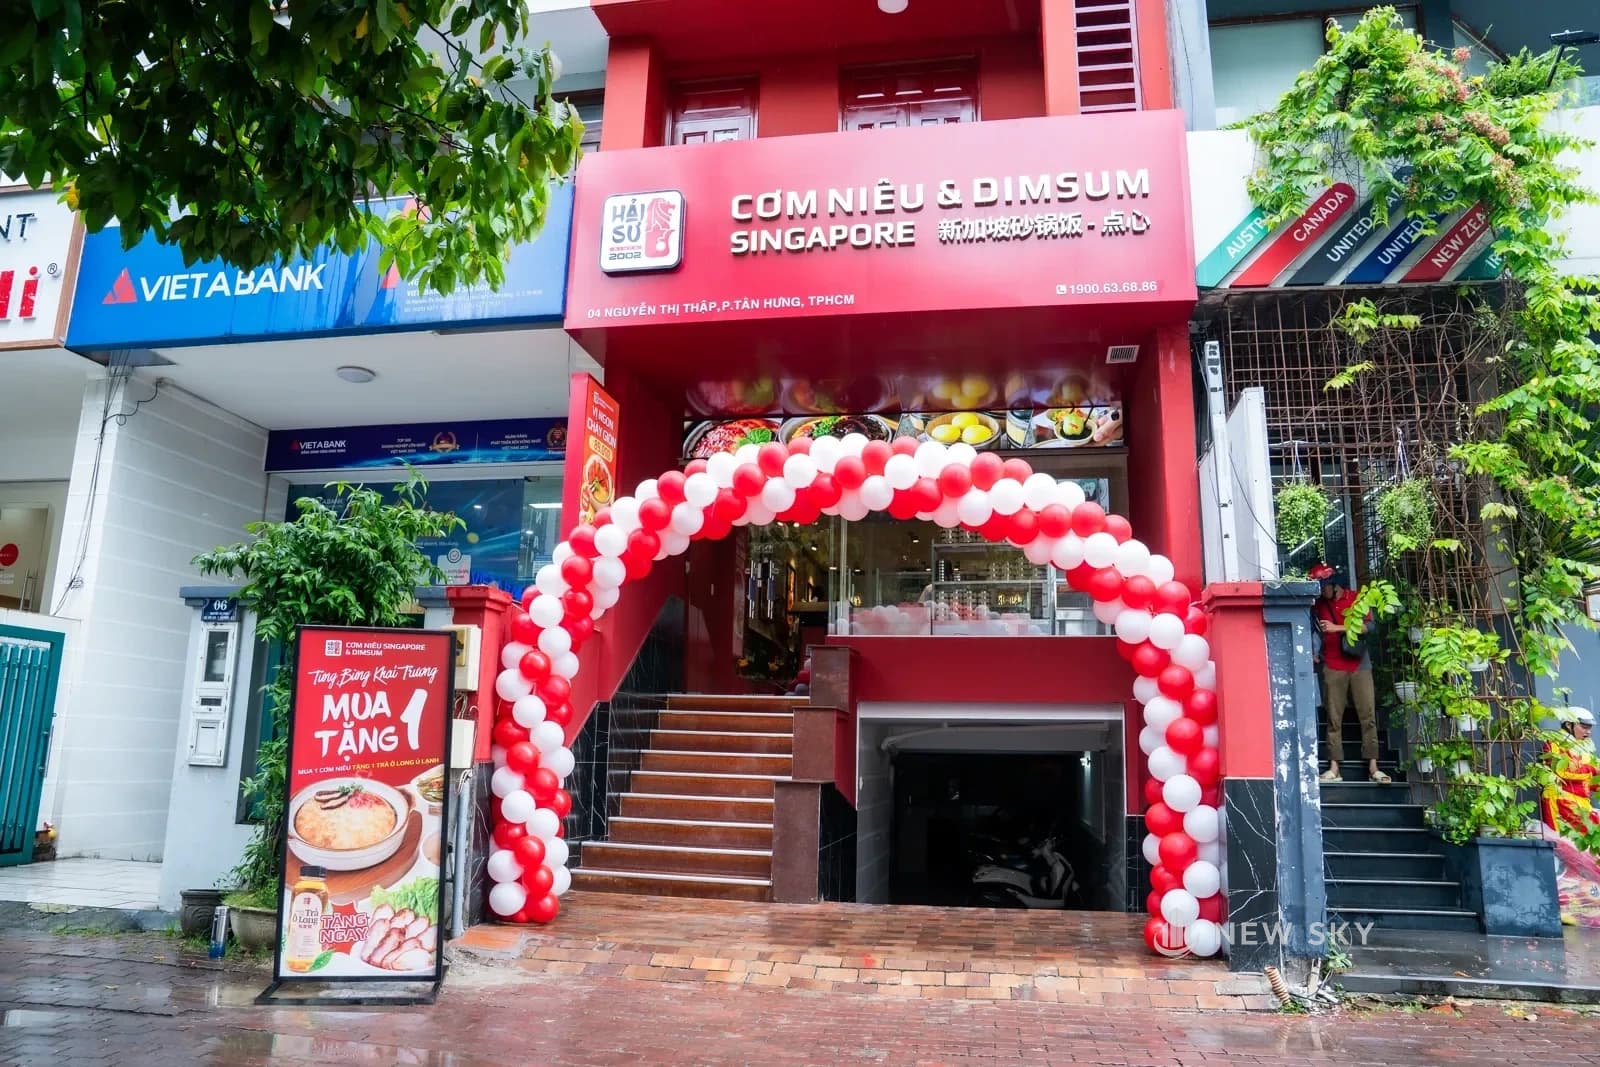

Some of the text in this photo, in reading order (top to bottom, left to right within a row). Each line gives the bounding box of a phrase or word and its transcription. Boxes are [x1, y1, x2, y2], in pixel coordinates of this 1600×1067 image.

[731, 168, 1150, 221] CƠM NIÊU & DIMSUM
[1102, 208, 1151, 237] 点心
[1293, 191, 1348, 241] CANADA
[730, 221, 915, 255] SINGAPORE
[1326, 216, 1373, 262] UNITED
[1377, 219, 1424, 265] UNITED
[1431, 233, 1460, 268] NEW
[608, 251, 642, 261] 2002
[140, 263, 327, 302] VIETABANK
[1069, 281, 1158, 296] 1900.63.68.86
[588, 308, 600, 319] 04
[605, 301, 656, 317] NGUYỄN
[660, 303, 680, 316] THỊ
[808, 294, 855, 306] TPHCM
[299, 440, 346, 450] VIETABANK
[213, 600, 228, 611] 06
[345, 641, 363, 649] CƠM
[364, 641, 382, 649] NIÊU
[383, 642, 426, 651] SINGAPORE
[373, 665, 399, 685] Khai
[322, 688, 428, 750] MUA 1
[314, 720, 399, 762] TẶNG
[396, 759, 414, 767] LONG
[320, 927, 368, 943] NGAY
